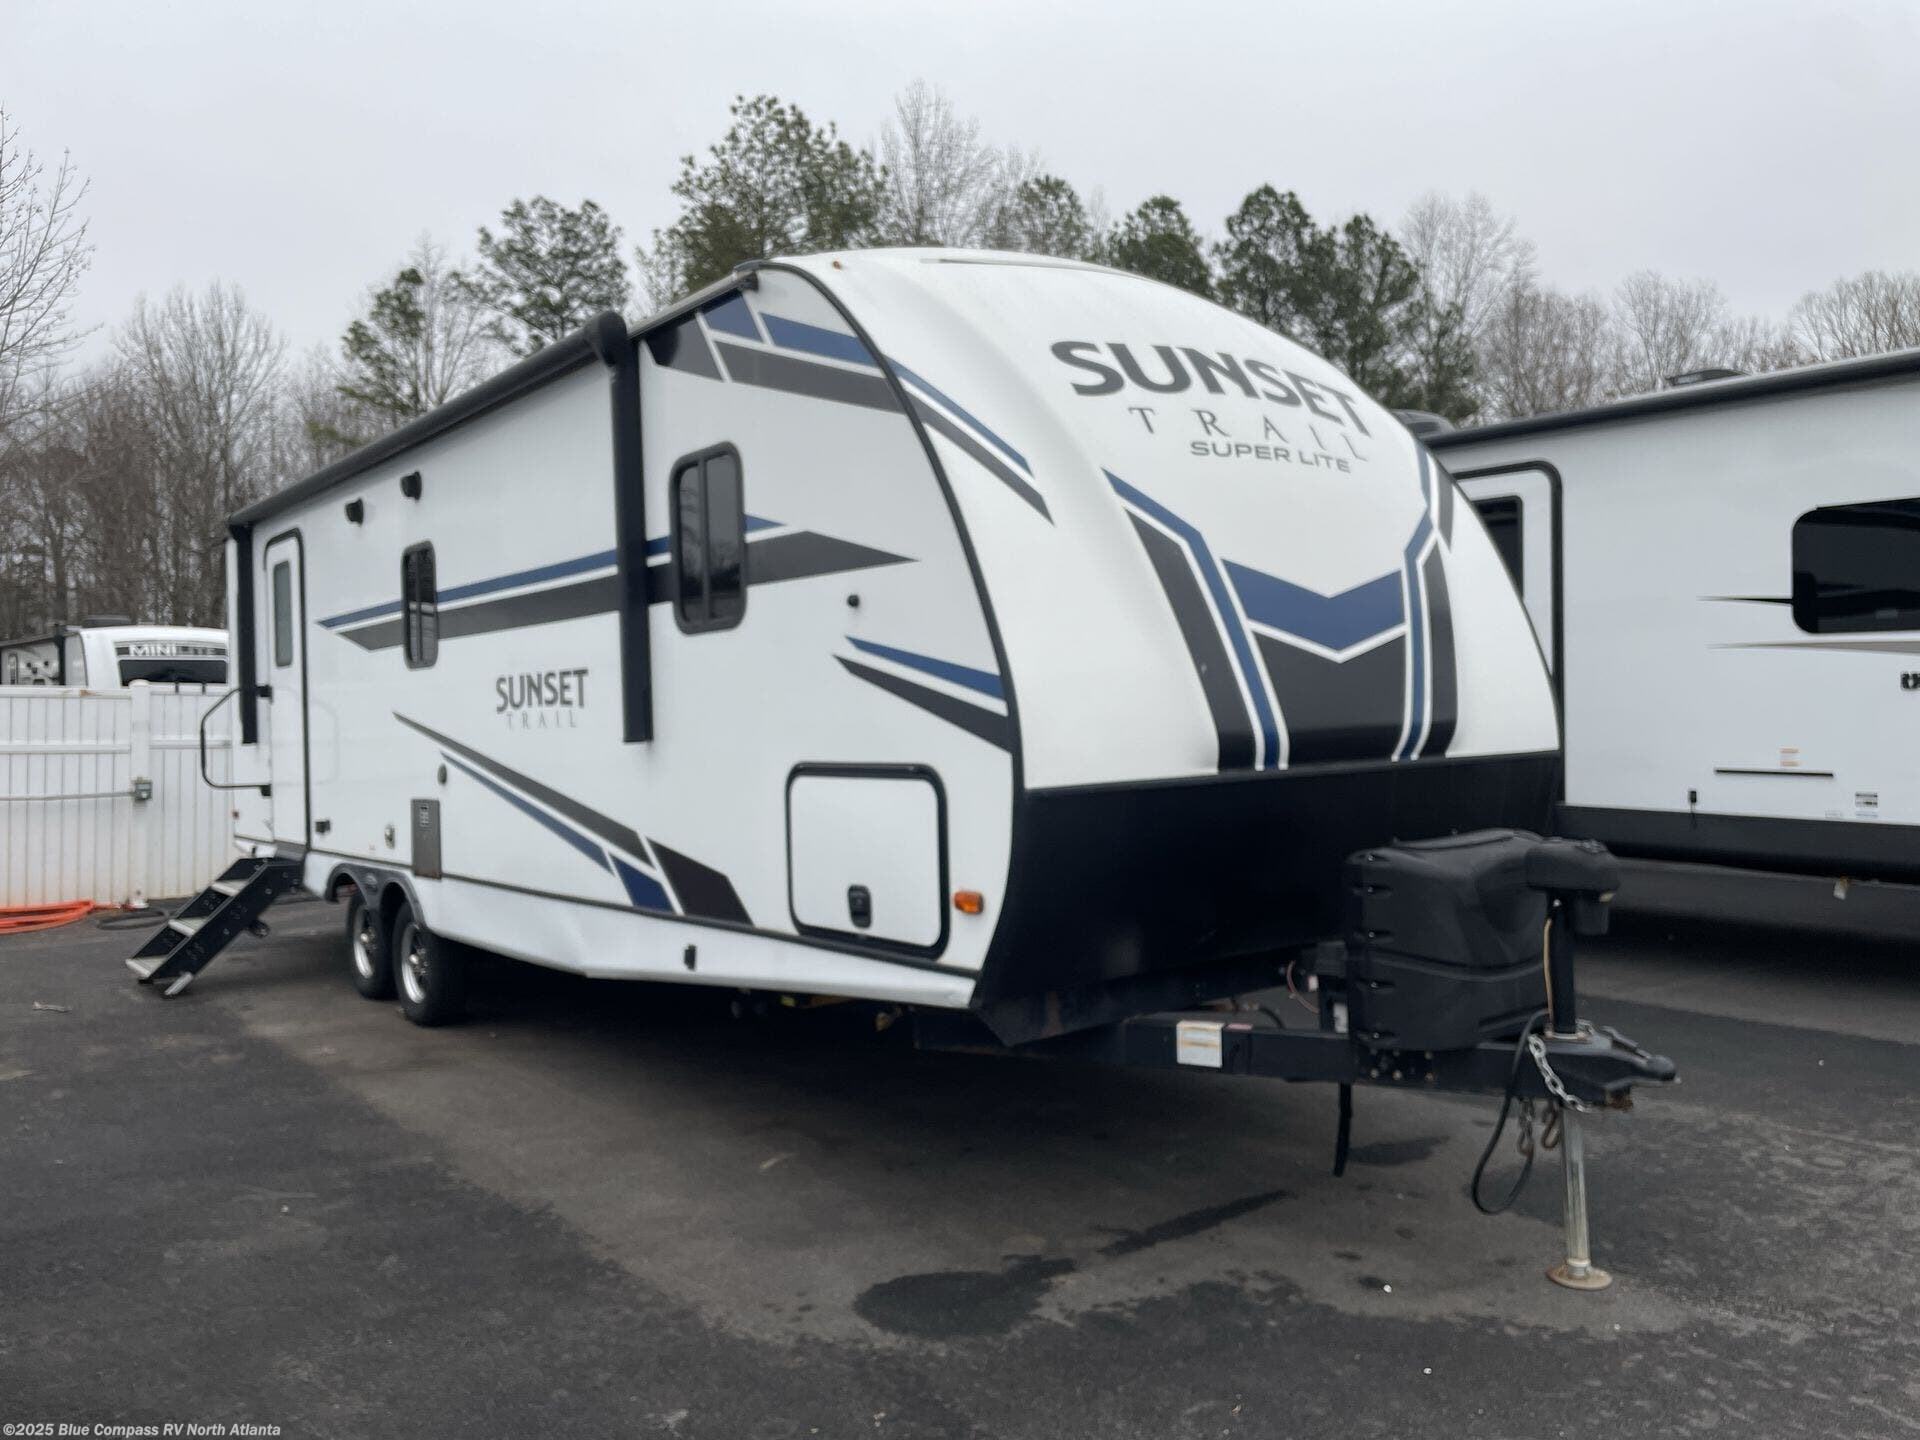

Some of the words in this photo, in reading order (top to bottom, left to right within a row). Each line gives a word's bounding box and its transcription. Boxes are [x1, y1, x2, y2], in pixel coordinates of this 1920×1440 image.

[1050, 340, 1371, 437] SUNSET
[1128, 406, 1368, 461] TRAIL
[1190, 440, 1292, 462] SUPER
[1300, 452, 1352, 473] LITE
[129, 644, 176, 656] MINI
[496, 668, 588, 713] SUNSET
[507, 710, 577, 729] TRAIL
